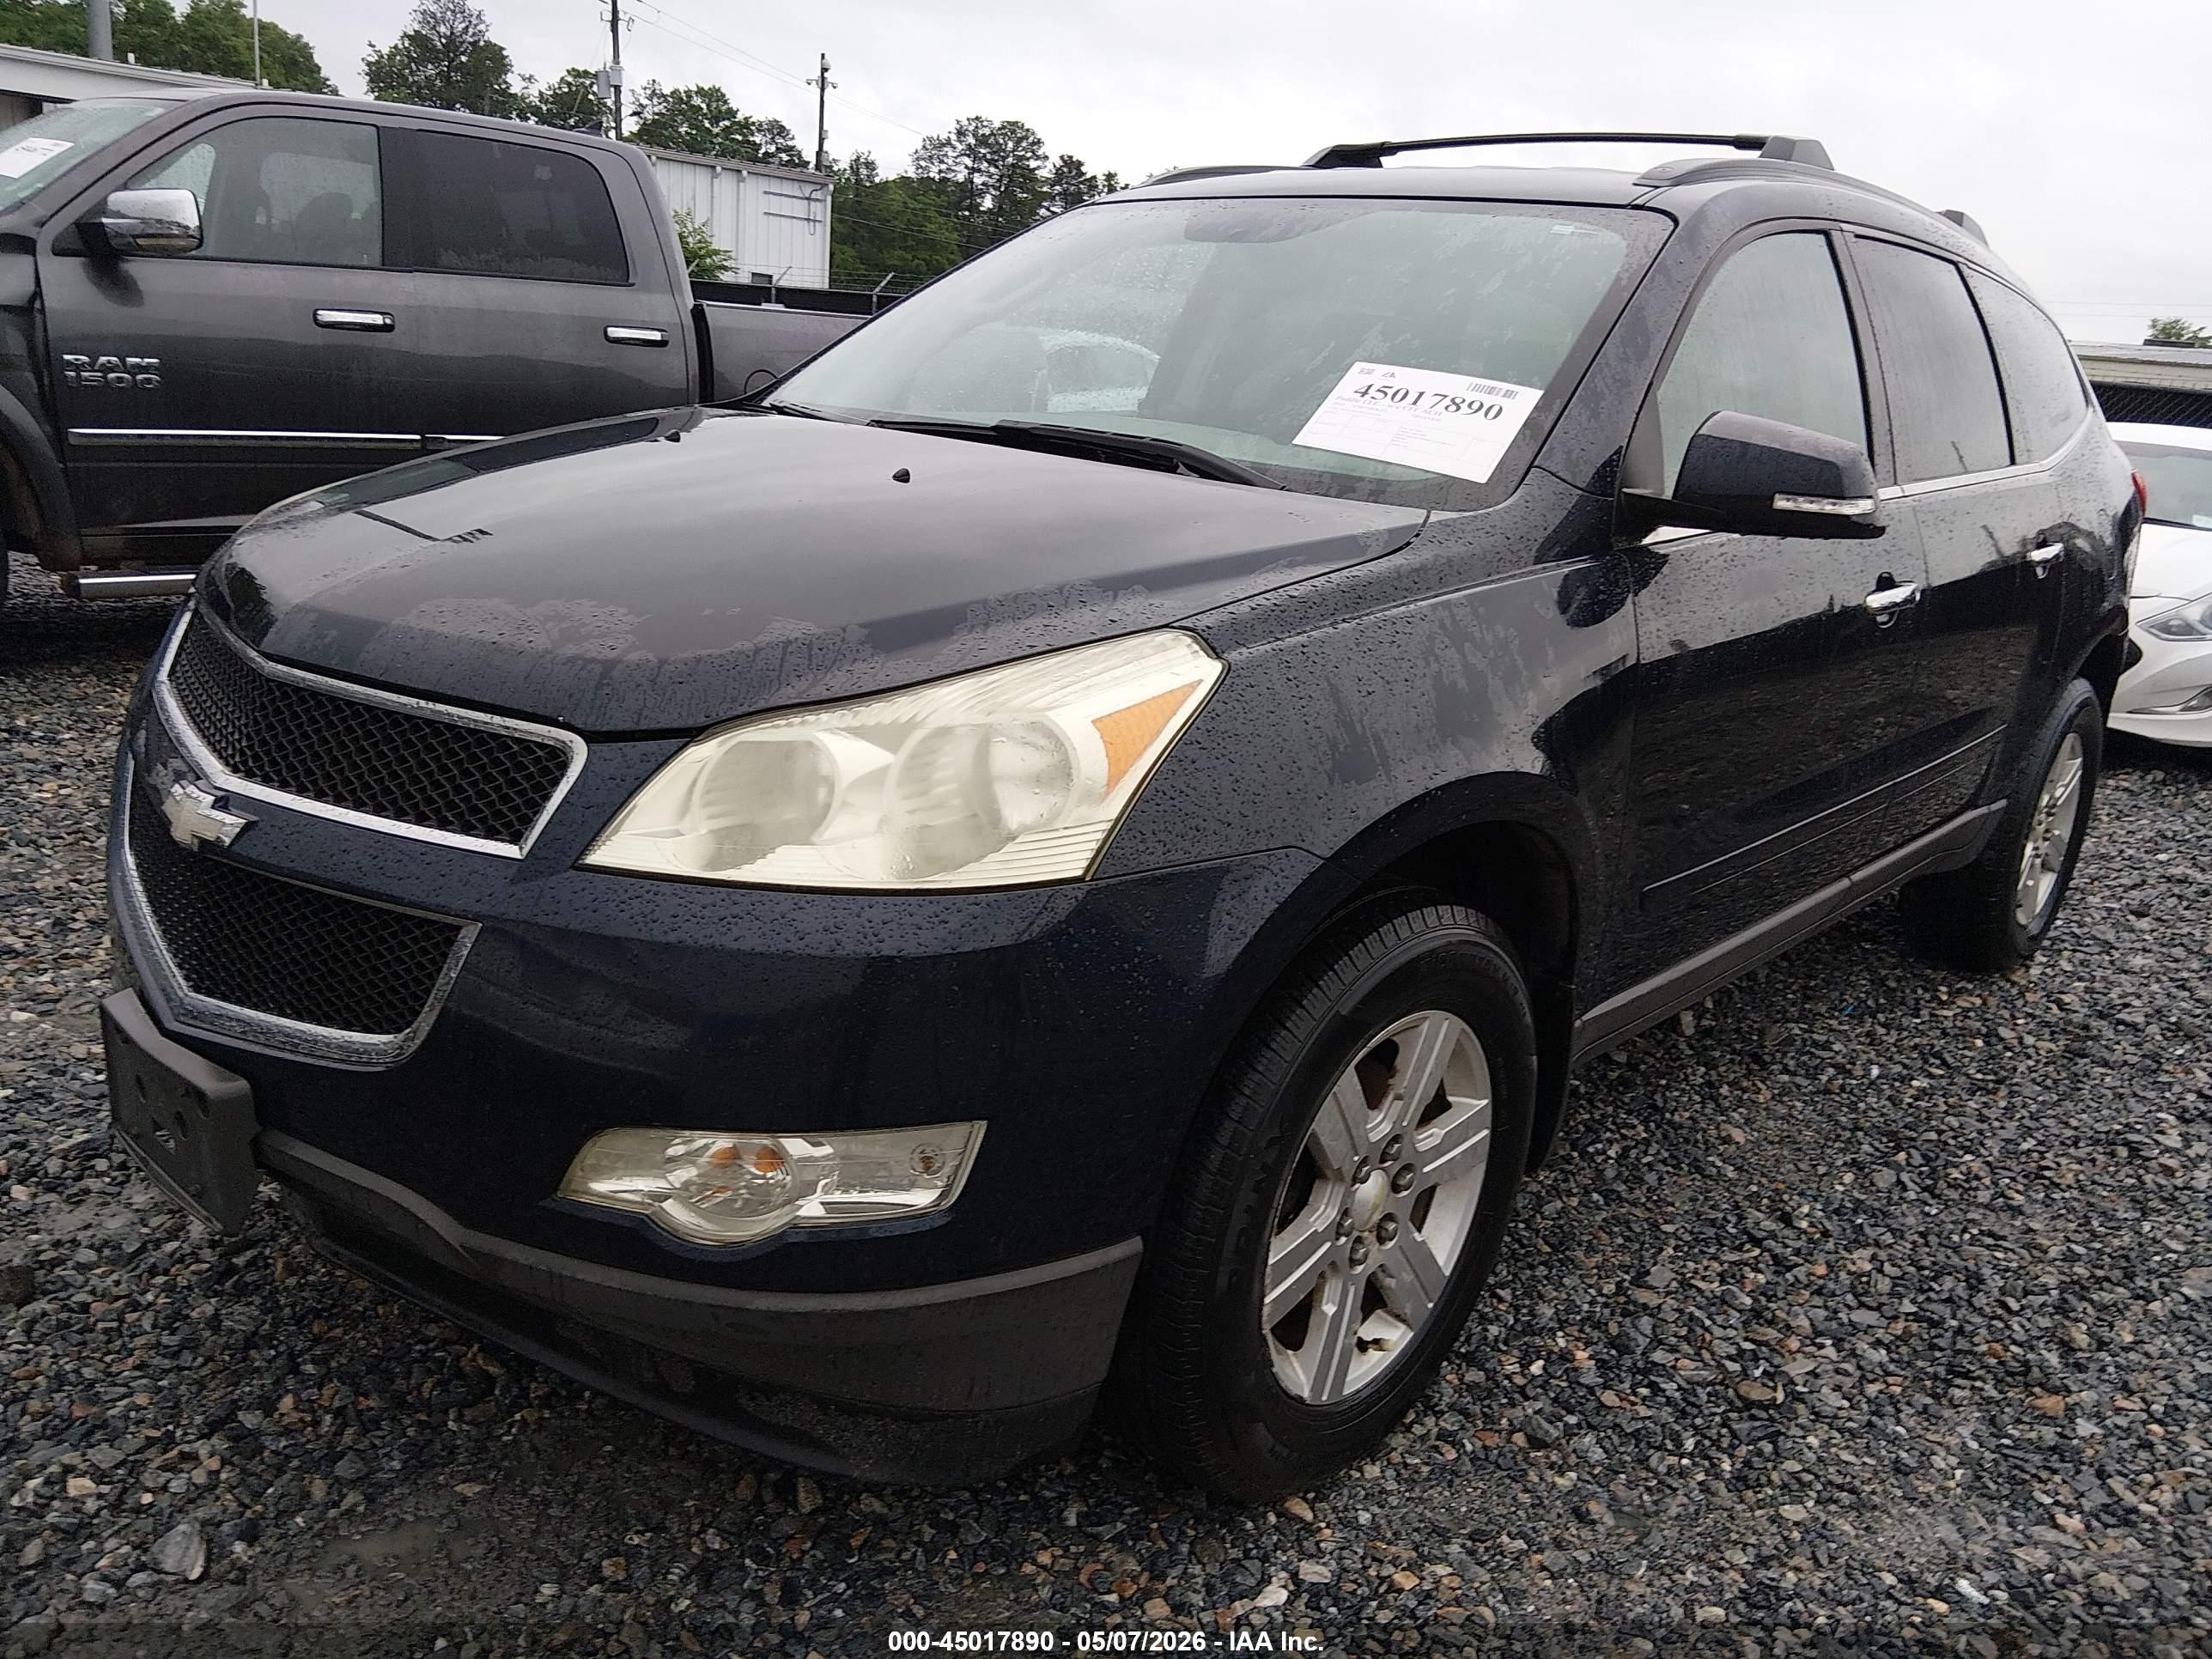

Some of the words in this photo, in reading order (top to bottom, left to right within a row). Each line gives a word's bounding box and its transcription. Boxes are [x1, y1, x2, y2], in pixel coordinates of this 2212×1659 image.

[62, 354, 161, 374] RAM
[64, 371, 161, 389] 1500
[1352, 383, 1503, 421] 45017890
